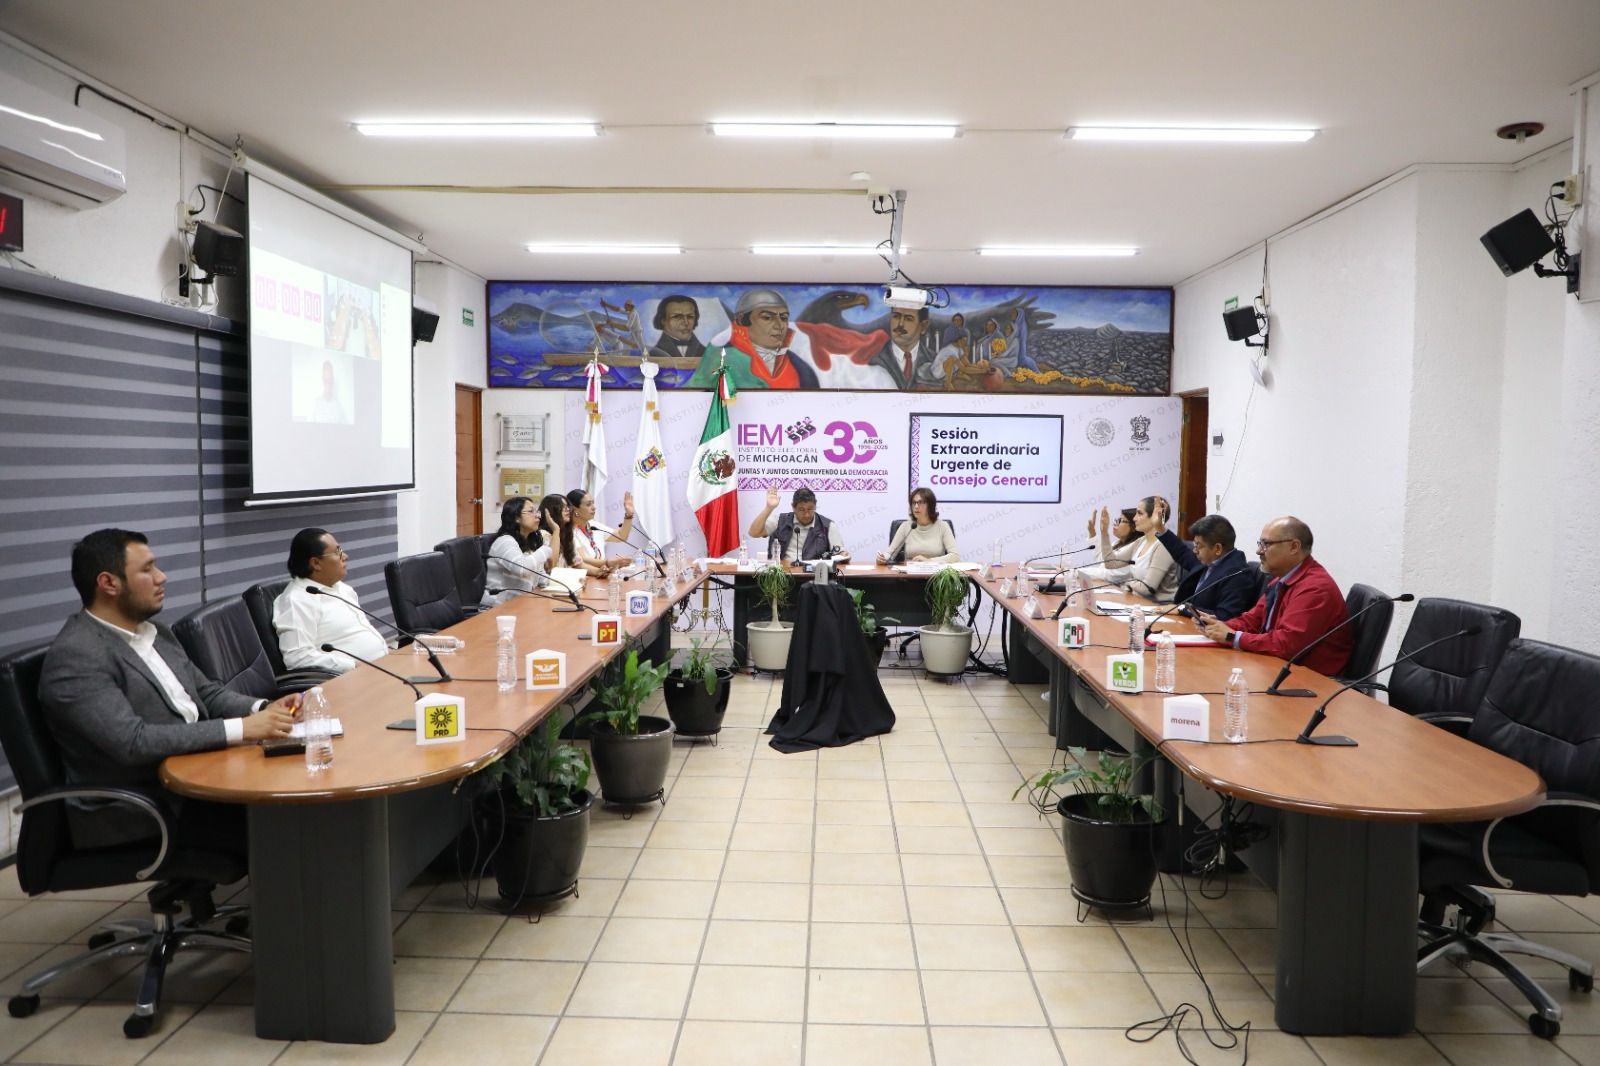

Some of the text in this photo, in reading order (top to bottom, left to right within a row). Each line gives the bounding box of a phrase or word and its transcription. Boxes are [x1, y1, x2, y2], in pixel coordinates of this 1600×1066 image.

[737, 423, 783, 446] IEM
[931, 427, 978, 439] Sesión
[822, 420, 878, 464] 30
[930, 443, 1040, 456] Extraordinaria
[738, 453, 818, 463] DE MICHOACÁN
[790, 468, 839, 476] CONSTRUYENDO
[930, 459, 1012, 472] Urgente de
[930, 473, 1048, 487] Consejo General
[633, 600, 646, 609] PAN
[599, 628, 616, 641] PT
[1063, 623, 1085, 645] PRI
[1170, 716, 1201, 727] morena
[433, 729, 450, 737] PRD
